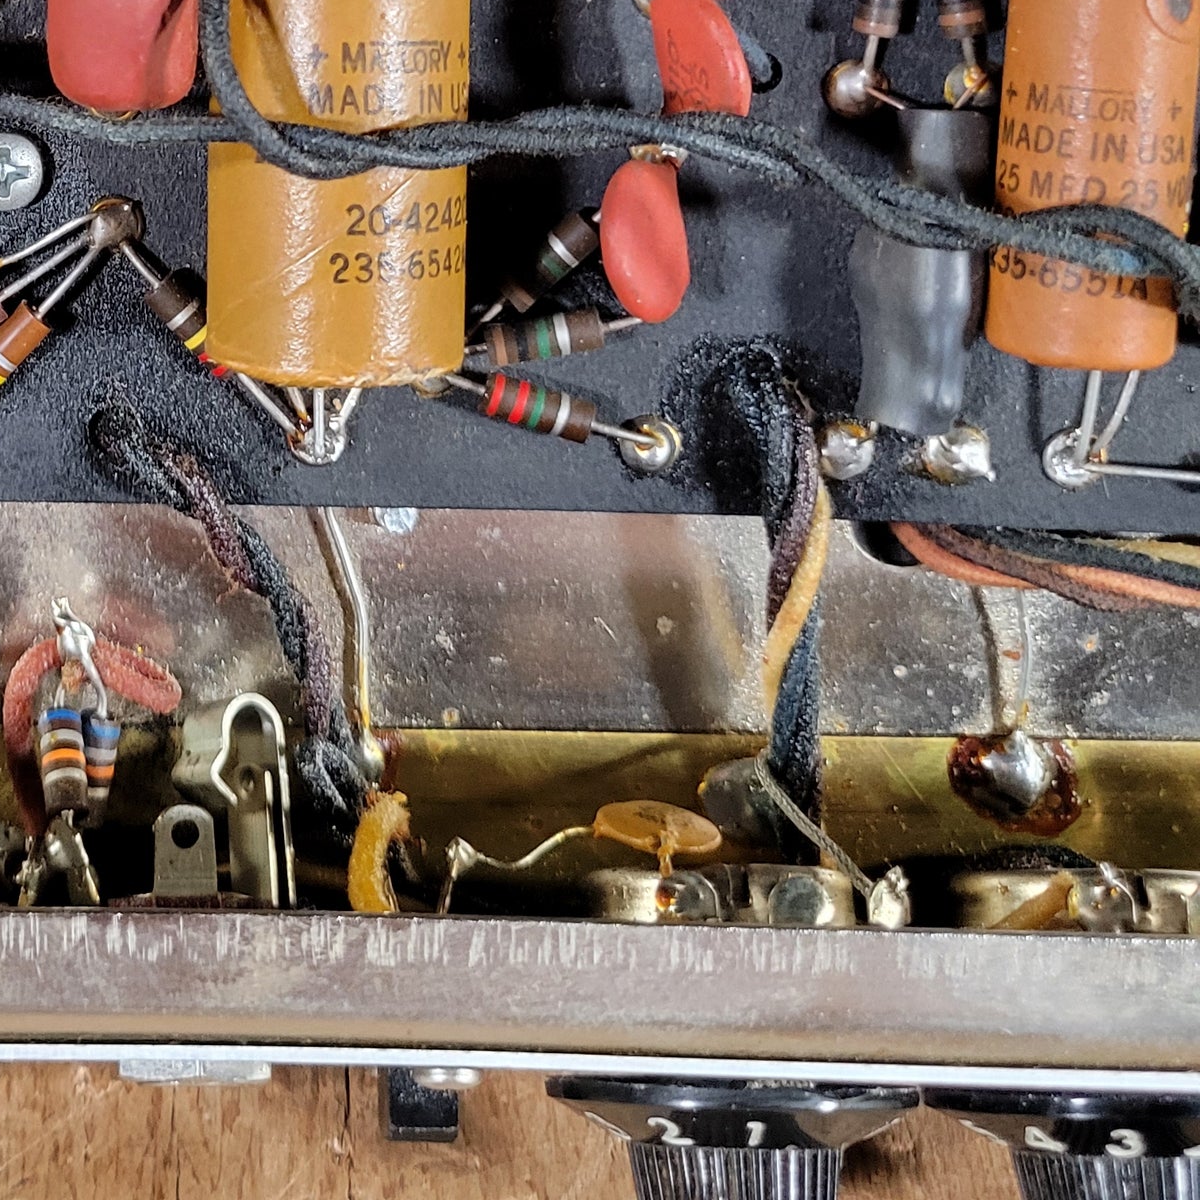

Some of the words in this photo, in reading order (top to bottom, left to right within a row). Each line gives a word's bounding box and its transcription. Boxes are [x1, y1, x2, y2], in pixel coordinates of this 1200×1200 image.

[309, 83, 404, 116] MAD
[419, 84, 443, 114] IN
[1002, 116, 1076, 159] MADE
[1090, 134, 1128, 164] IN
[1138, 134, 1186, 166] USA
[329, 243, 465, 284] 23-6542
[647, 1116, 696, 1146] 2
[747, 1120, 766, 1147] 1
[1025, 1126, 1069, 1153] 4
[1105, 1128, 1146, 1158] 3
